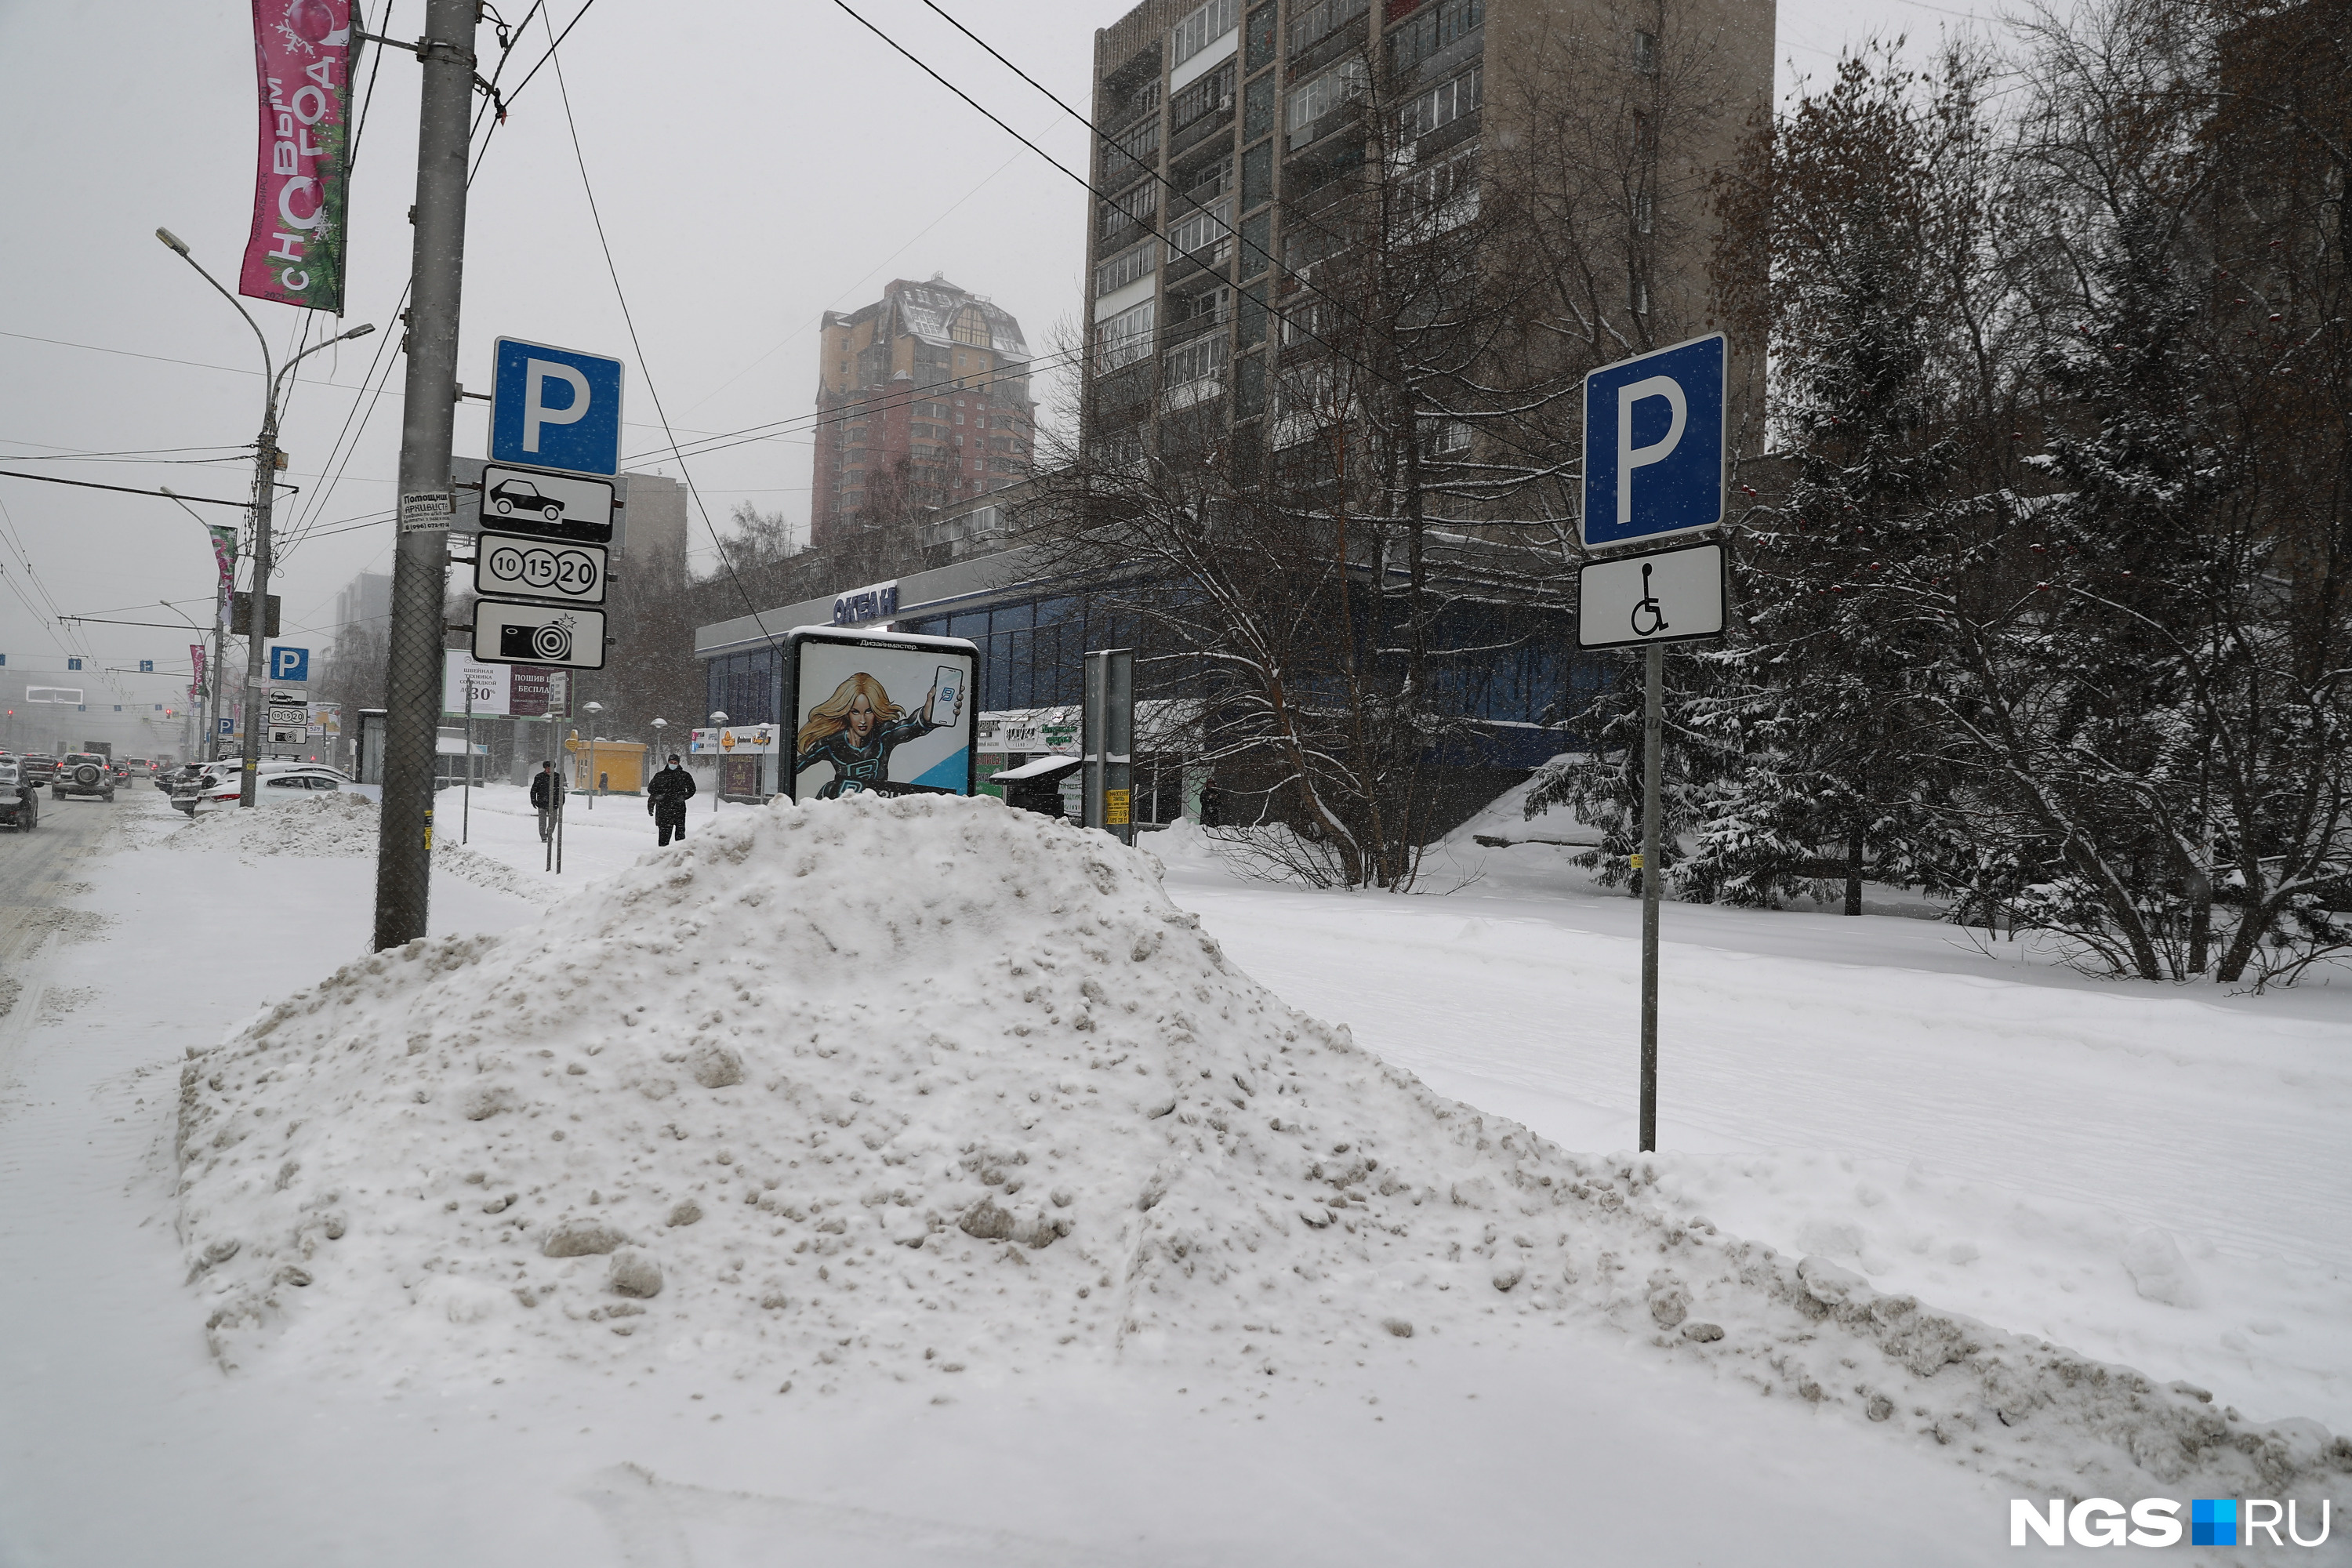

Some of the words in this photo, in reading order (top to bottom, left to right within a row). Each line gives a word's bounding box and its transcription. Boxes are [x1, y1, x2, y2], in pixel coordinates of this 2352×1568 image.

[338, 38, 347, 115] НОВОСИБИРСК
[253, 172, 268, 242] НОВОСИБИРСК
[263, 290, 285, 301] 2021
[523, 358, 591, 453] P
[1617, 375, 1687, 524] P
[497, 557, 516, 571] 10
[529, 558, 552, 578] 15
[561, 561, 592, 583] 20
[833, 586, 896, 626] ОКЕАН
[279, 650, 300, 677] P
[518, 685, 550, 694] БЕСПЛА
[220, 720, 230, 733] P
